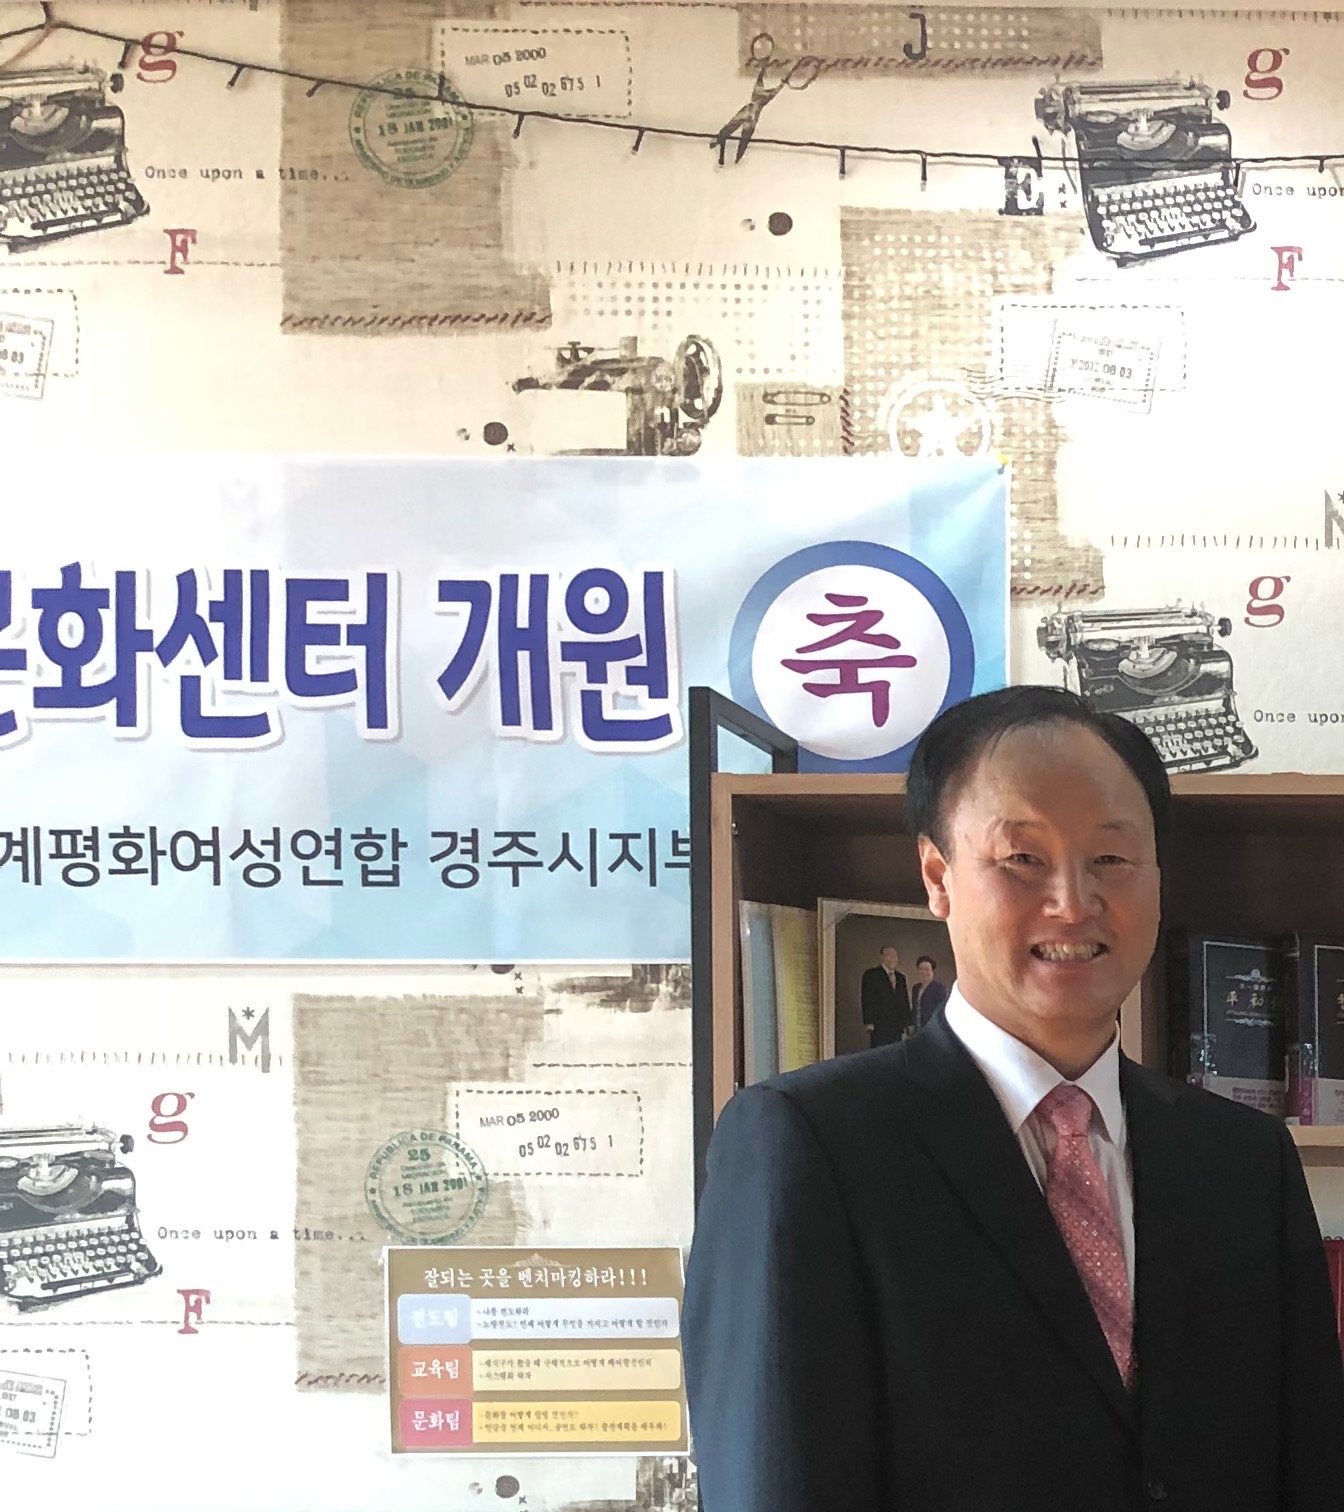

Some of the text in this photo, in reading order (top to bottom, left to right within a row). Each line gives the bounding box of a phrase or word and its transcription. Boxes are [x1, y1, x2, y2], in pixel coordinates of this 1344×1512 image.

[1243, 47, 1290, 100] g
[1251, 180, 1297, 198] Once
[163, 228, 197, 275] F
[1269, 245, 1304, 292] F
[1243, 574, 1291, 627] g
[0, 562, 680, 742] 화센터 개원
[780, 592, 918, 729] 축
[1252, 708, 1296, 725] Once
[0, 824, 407, 889] 계평화여성연합
[146, 1091, 195, 1145] g
[528, 1107, 560, 1123] 2000
[157, 1225, 202, 1241] Once
[213, 1227, 258, 1244] upon
[270, 1228, 279, 1241] a
[423, 1267, 648, 1289] 잘되는 곳을 벤치마킹하라!!!
[176, 1288, 211, 1335] F
[411, 1358, 460, 1380] 교육팀
[411, 1409, 460, 1432] 문화팀
